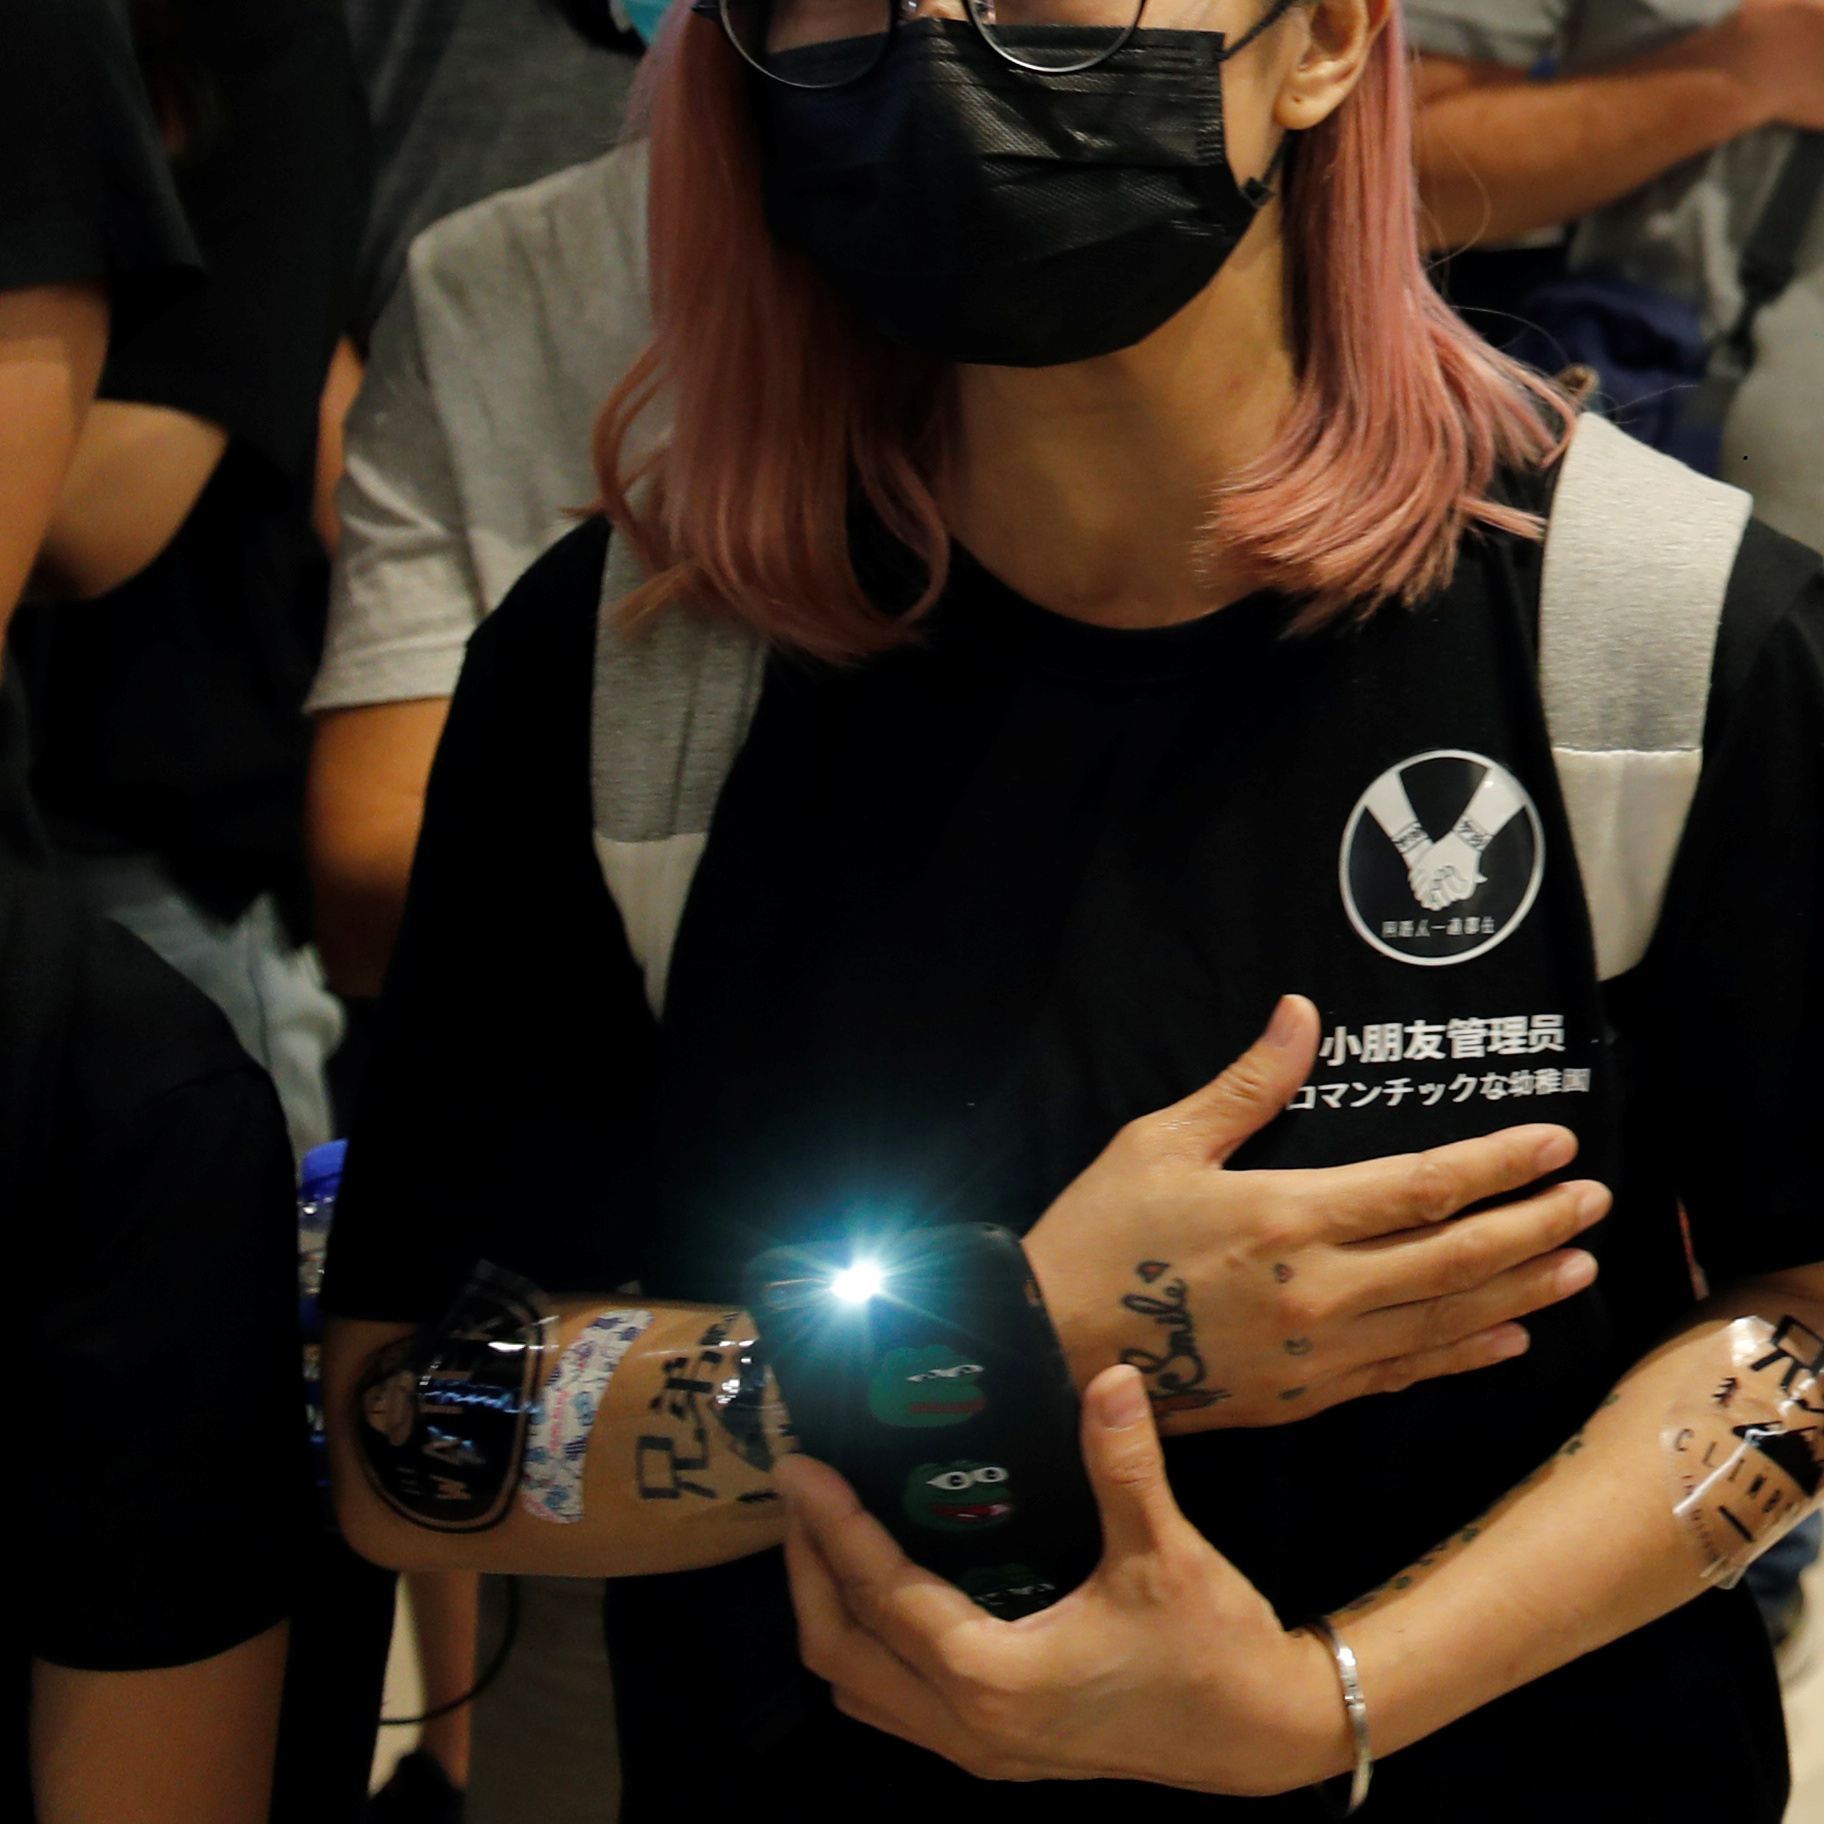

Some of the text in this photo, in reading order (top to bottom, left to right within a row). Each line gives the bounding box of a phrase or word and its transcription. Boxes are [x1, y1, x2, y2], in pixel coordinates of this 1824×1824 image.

[1318, 1013, 1566, 1067] 小朋友管理员
